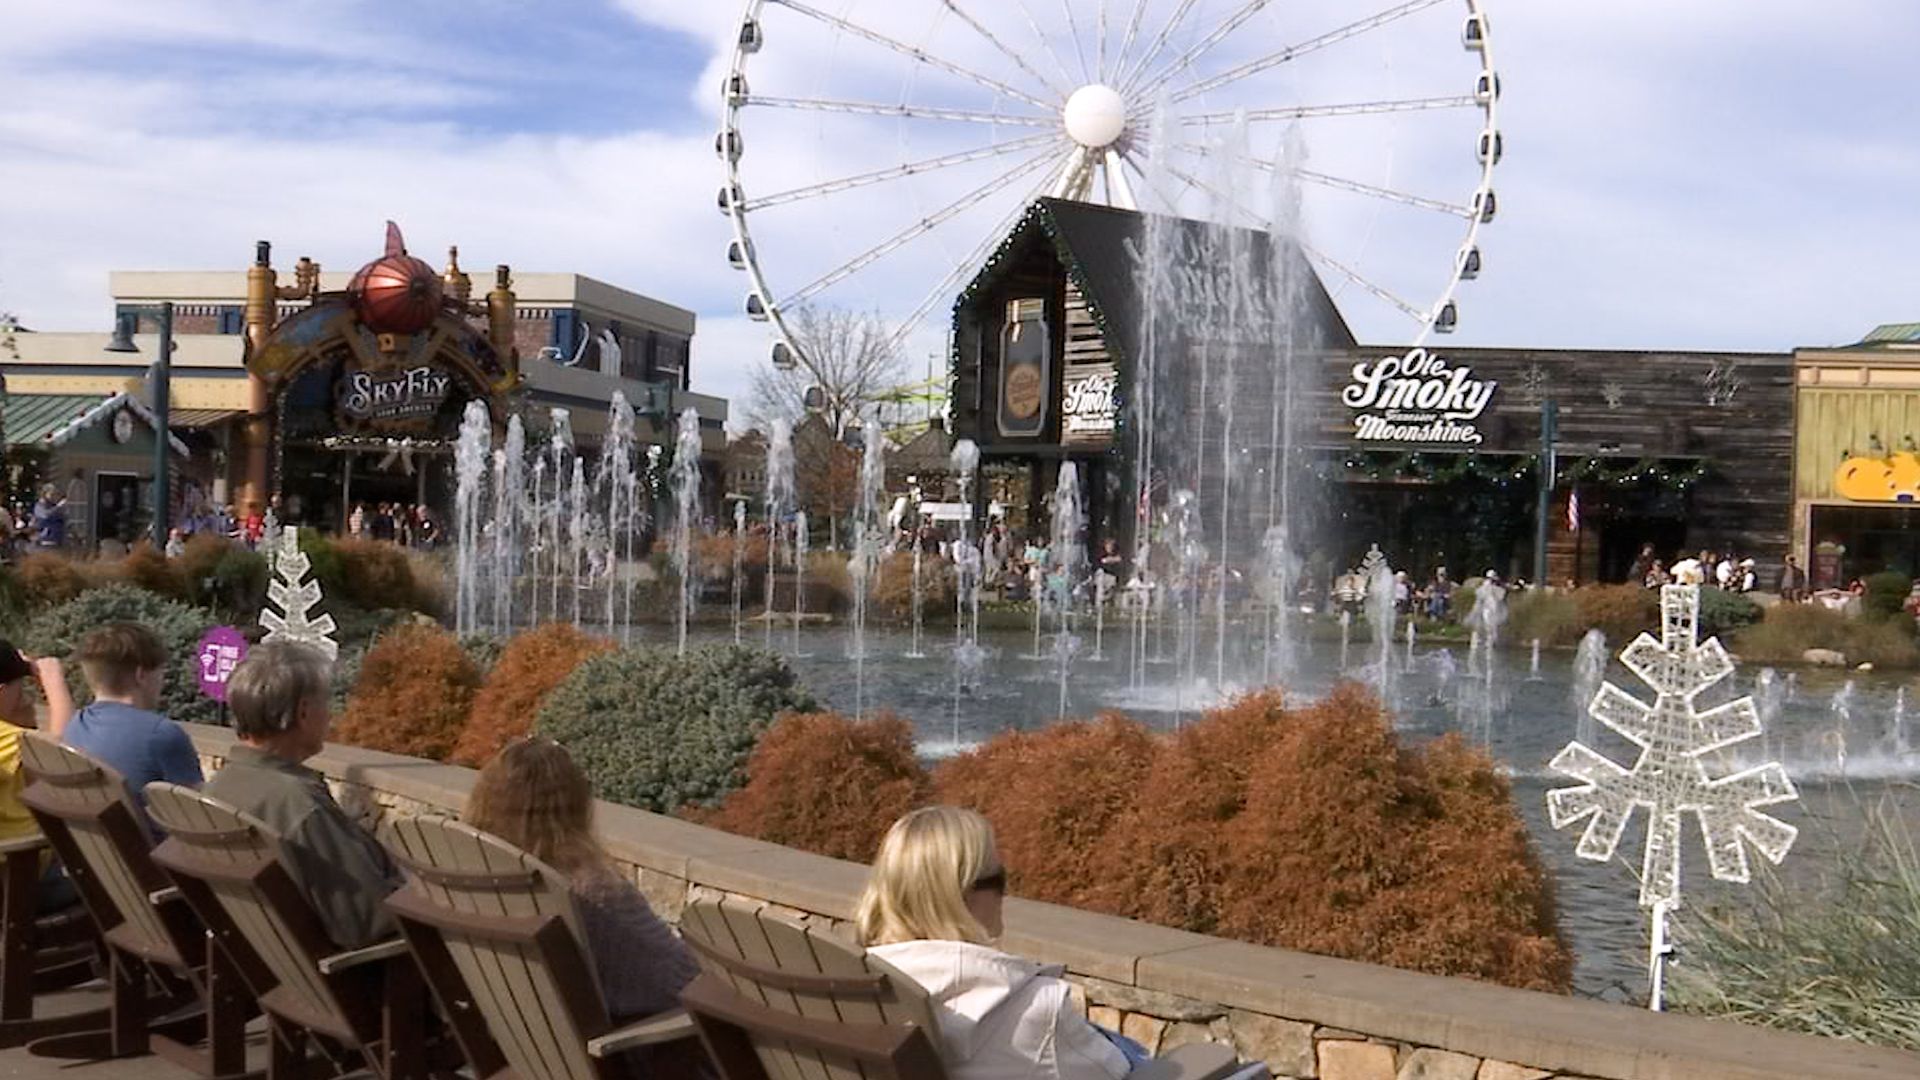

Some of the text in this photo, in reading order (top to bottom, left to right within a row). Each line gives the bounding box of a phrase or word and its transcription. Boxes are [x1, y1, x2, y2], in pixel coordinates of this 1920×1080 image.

[1401, 348, 1451, 378] Ole
[1342, 356, 1498, 420] Smoky
[1354, 414, 1483, 445] Moonshine
